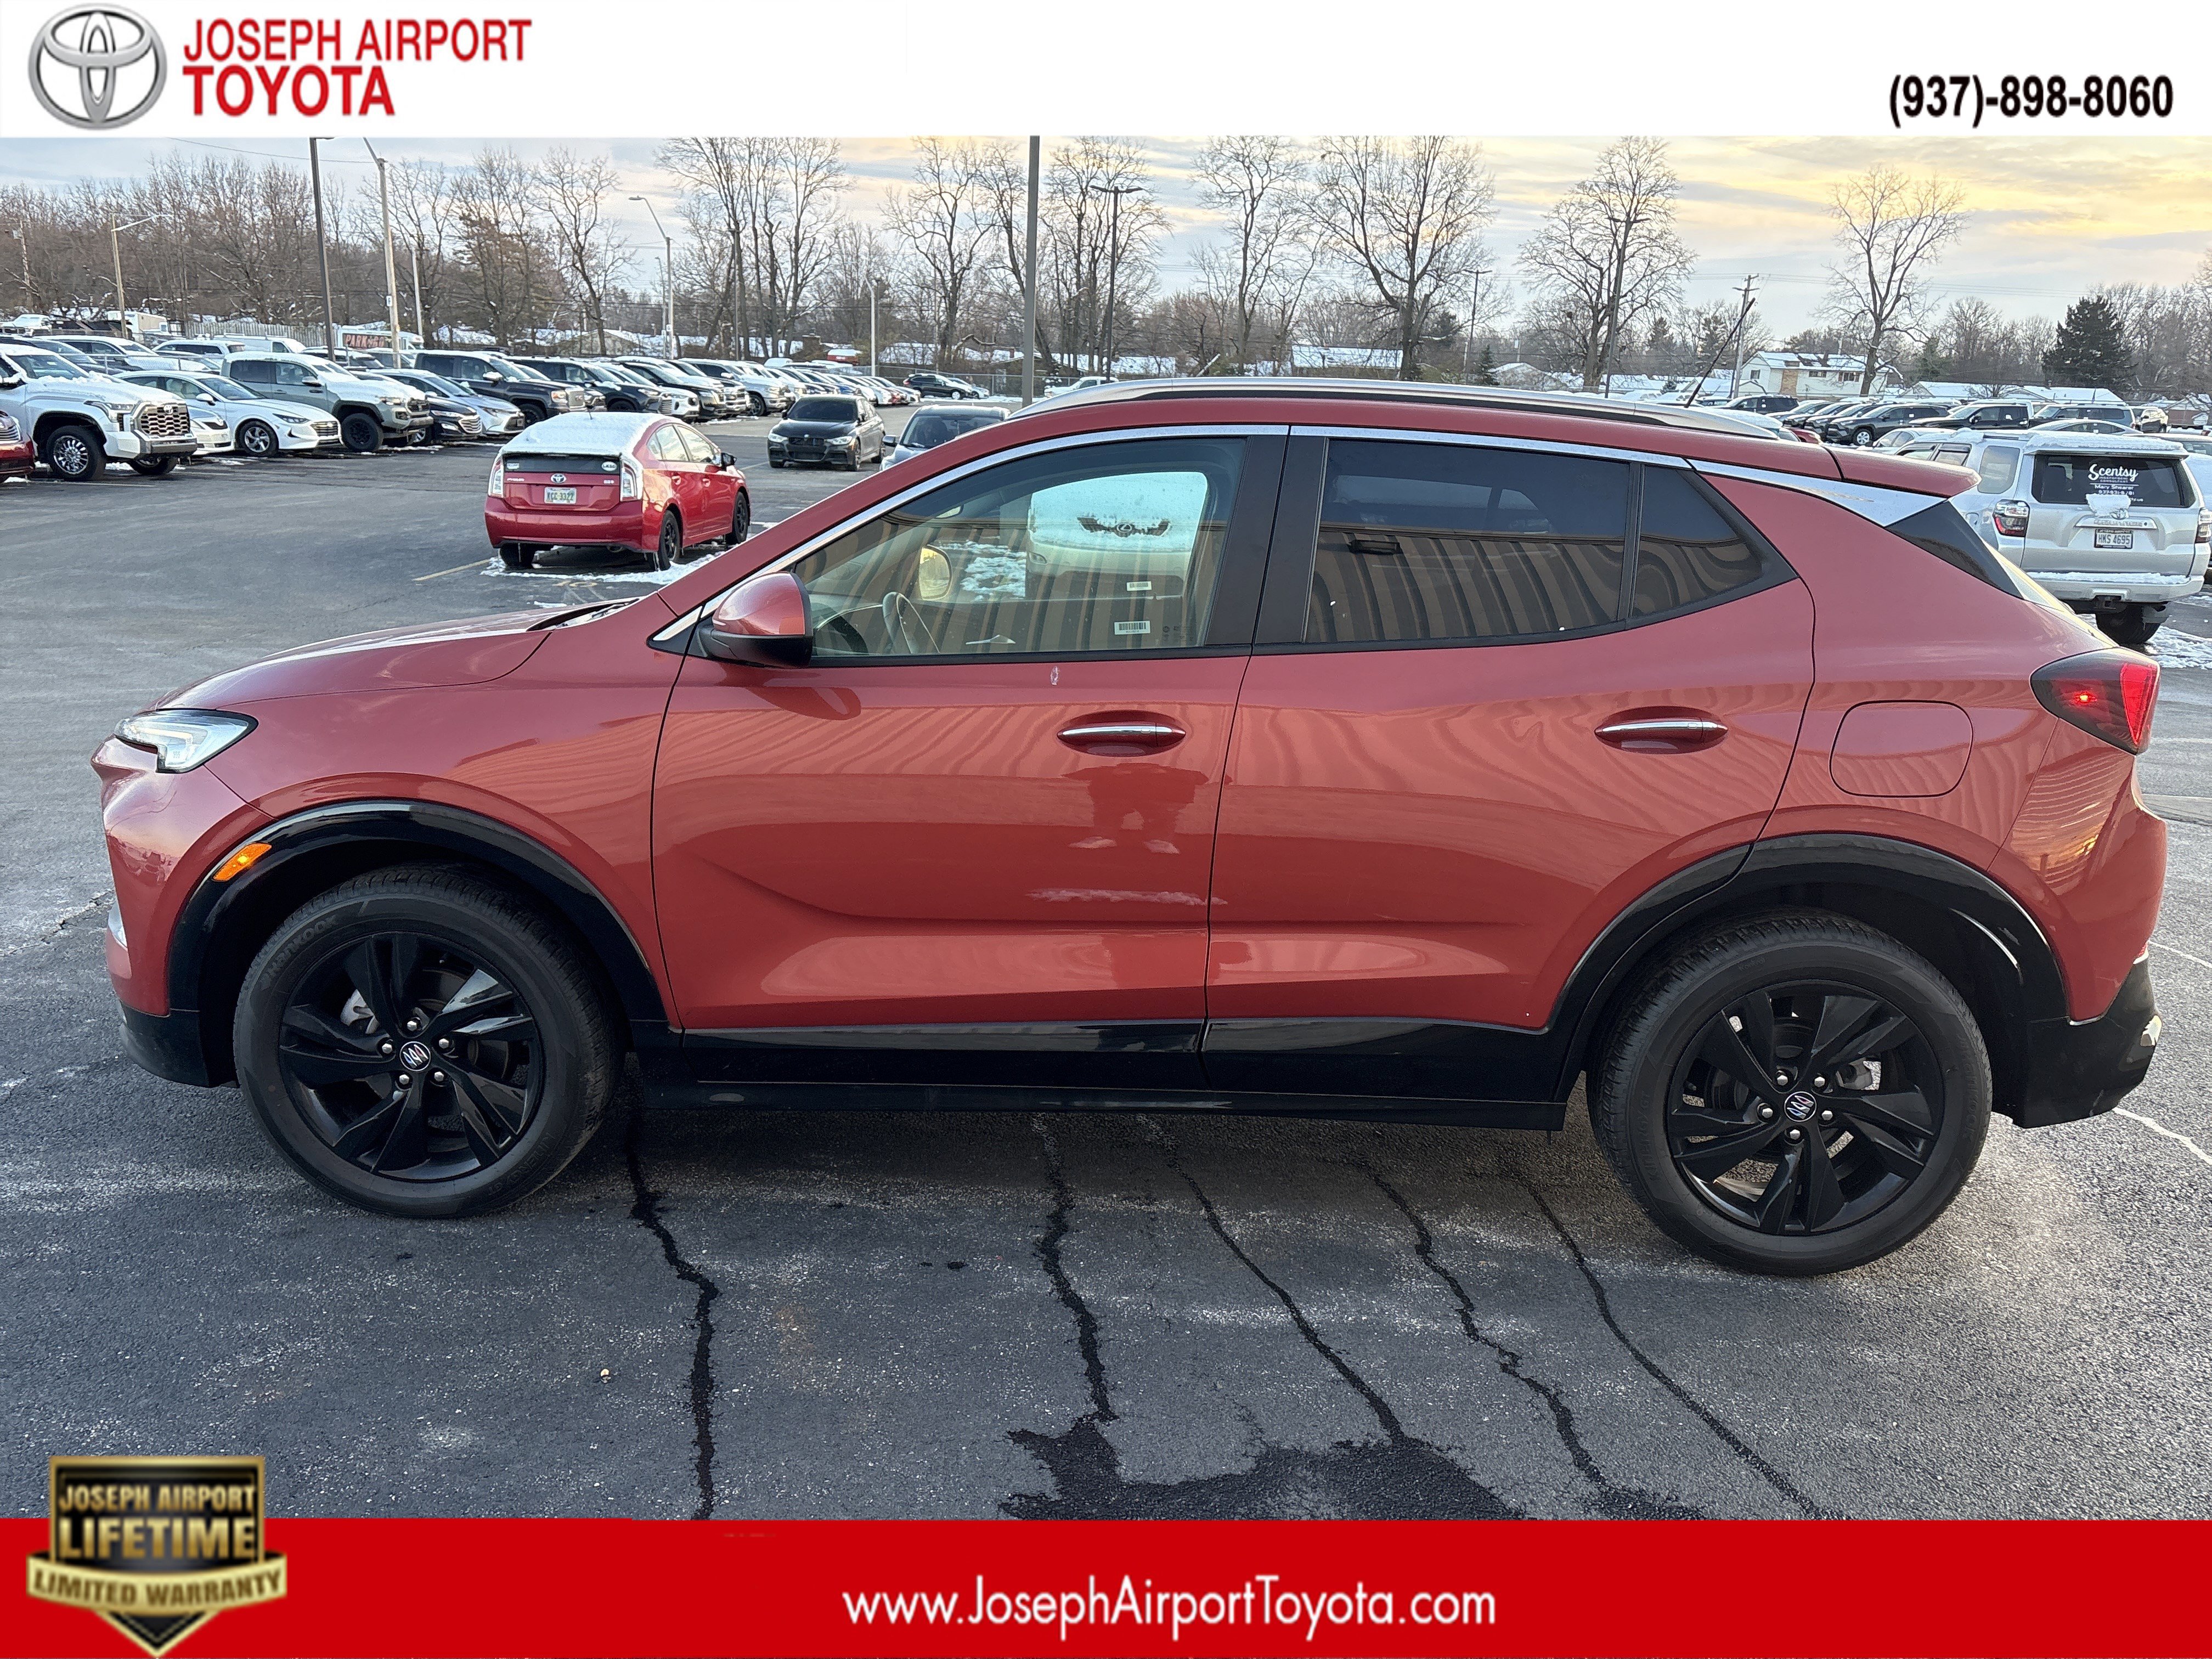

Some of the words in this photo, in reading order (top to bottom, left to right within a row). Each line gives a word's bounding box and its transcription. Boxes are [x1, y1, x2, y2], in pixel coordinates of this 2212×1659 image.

[345, 335, 368, 347] PARK
[2088, 464, 2138, 482] Scentsy
[2098, 534, 2111, 544] HKS
[2113, 534, 2130, 545] 4695
